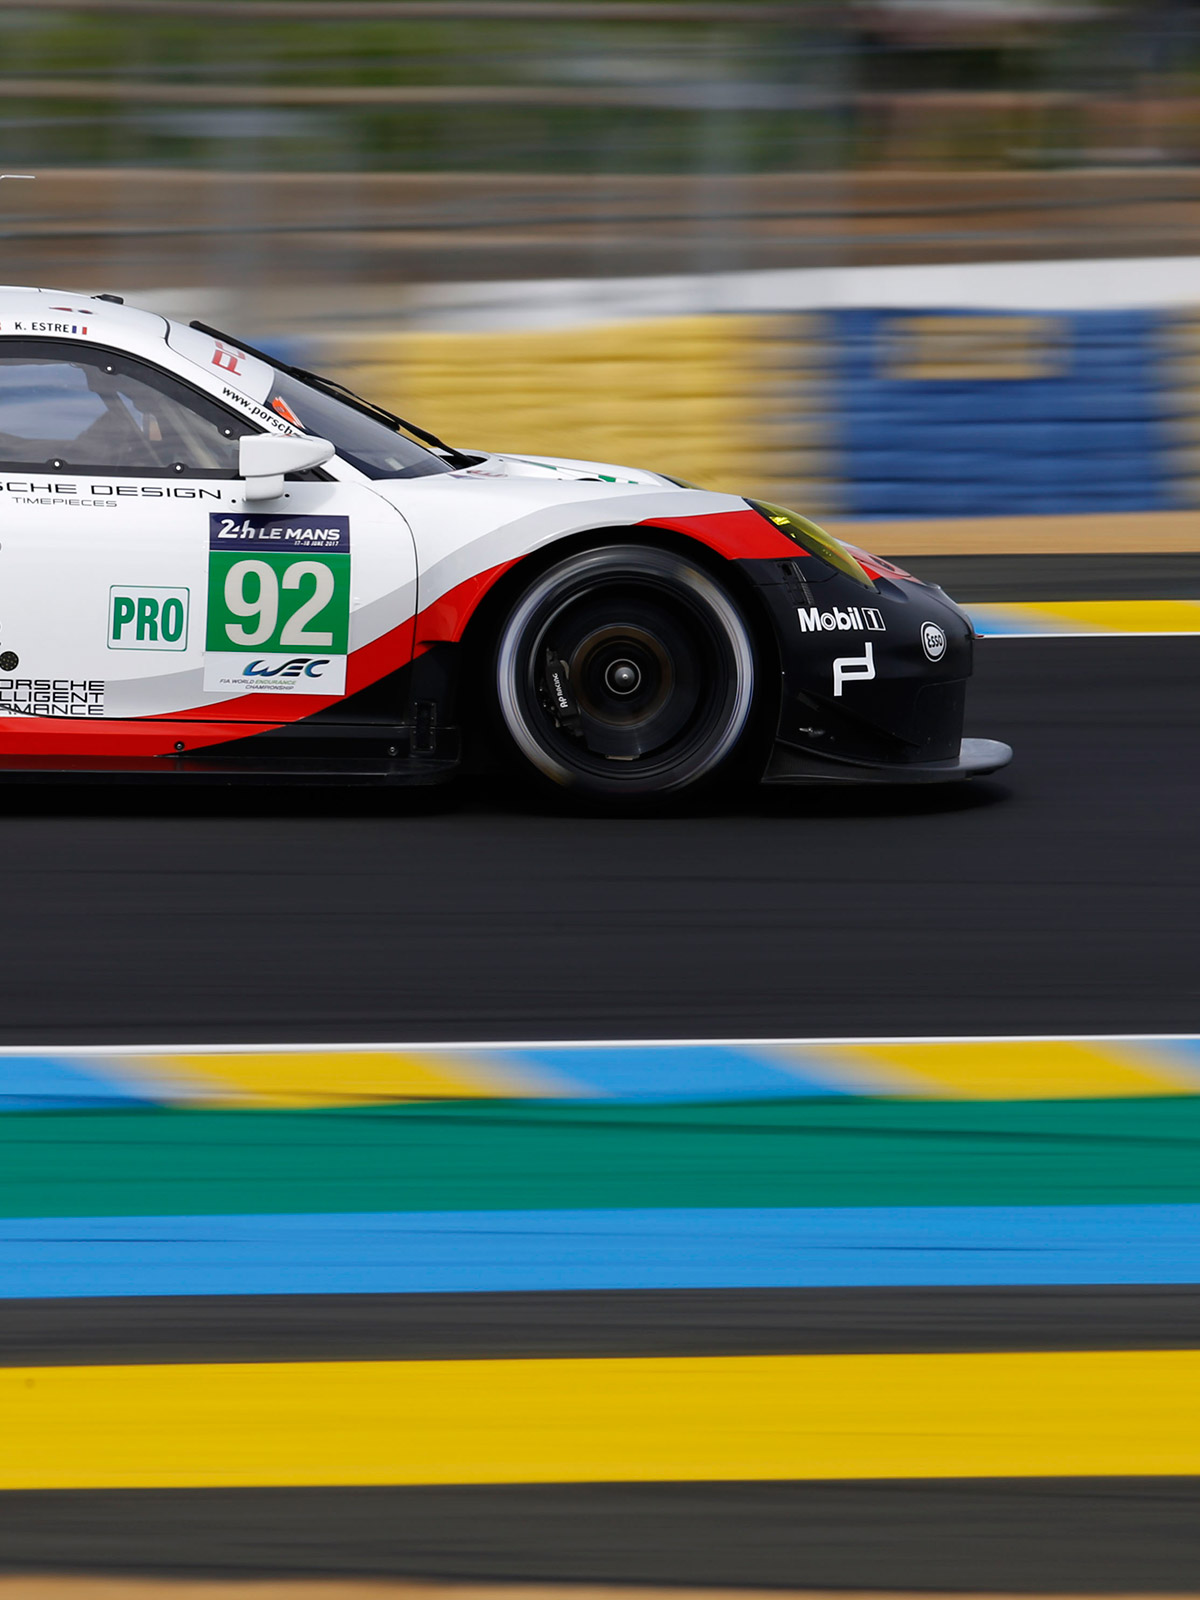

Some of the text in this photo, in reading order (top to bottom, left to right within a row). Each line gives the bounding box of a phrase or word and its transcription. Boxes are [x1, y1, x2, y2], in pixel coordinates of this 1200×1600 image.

[14, 321, 70, 333] K. ESTRE
[91, 484, 222, 500] DESIGN
[11, 496, 118, 508] TIMEPIECES
[258, 527, 283, 540] LE
[284, 528, 340, 541] MANS
[224, 559, 335, 646] 92
[112, 596, 184, 642] PRO
[797, 606, 864, 632] Mobil
[926, 632, 943, 649] Esso
[242, 657, 331, 678] WEC
